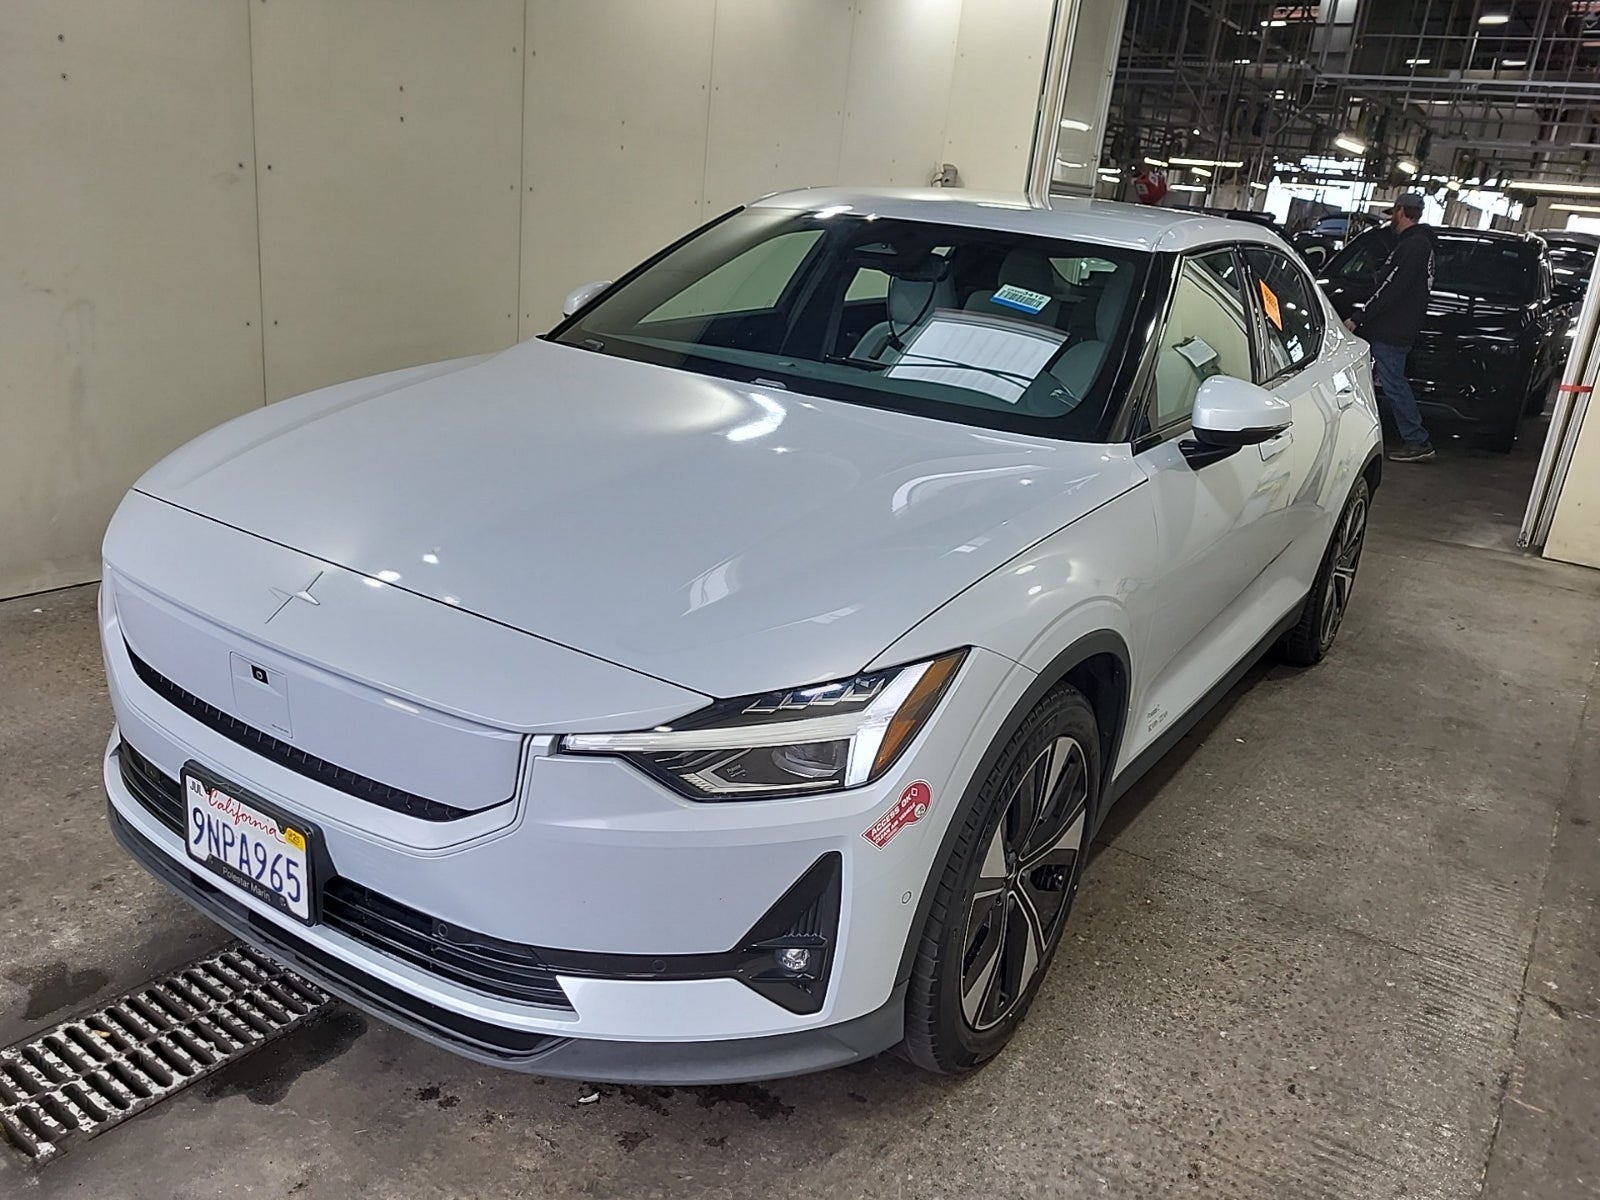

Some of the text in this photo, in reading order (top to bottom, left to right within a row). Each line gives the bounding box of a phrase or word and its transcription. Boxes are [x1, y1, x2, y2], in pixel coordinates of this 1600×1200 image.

[189, 780, 204, 797] JUL
[207, 787, 287, 845] California
[871, 806, 900, 837] ACCESS
[901, 793, 912, 808] OK
[192, 806, 301, 903] 9NPA965
[875, 828, 891, 844] CLEAN
[222, 866, 272, 902] Polestar Marin
